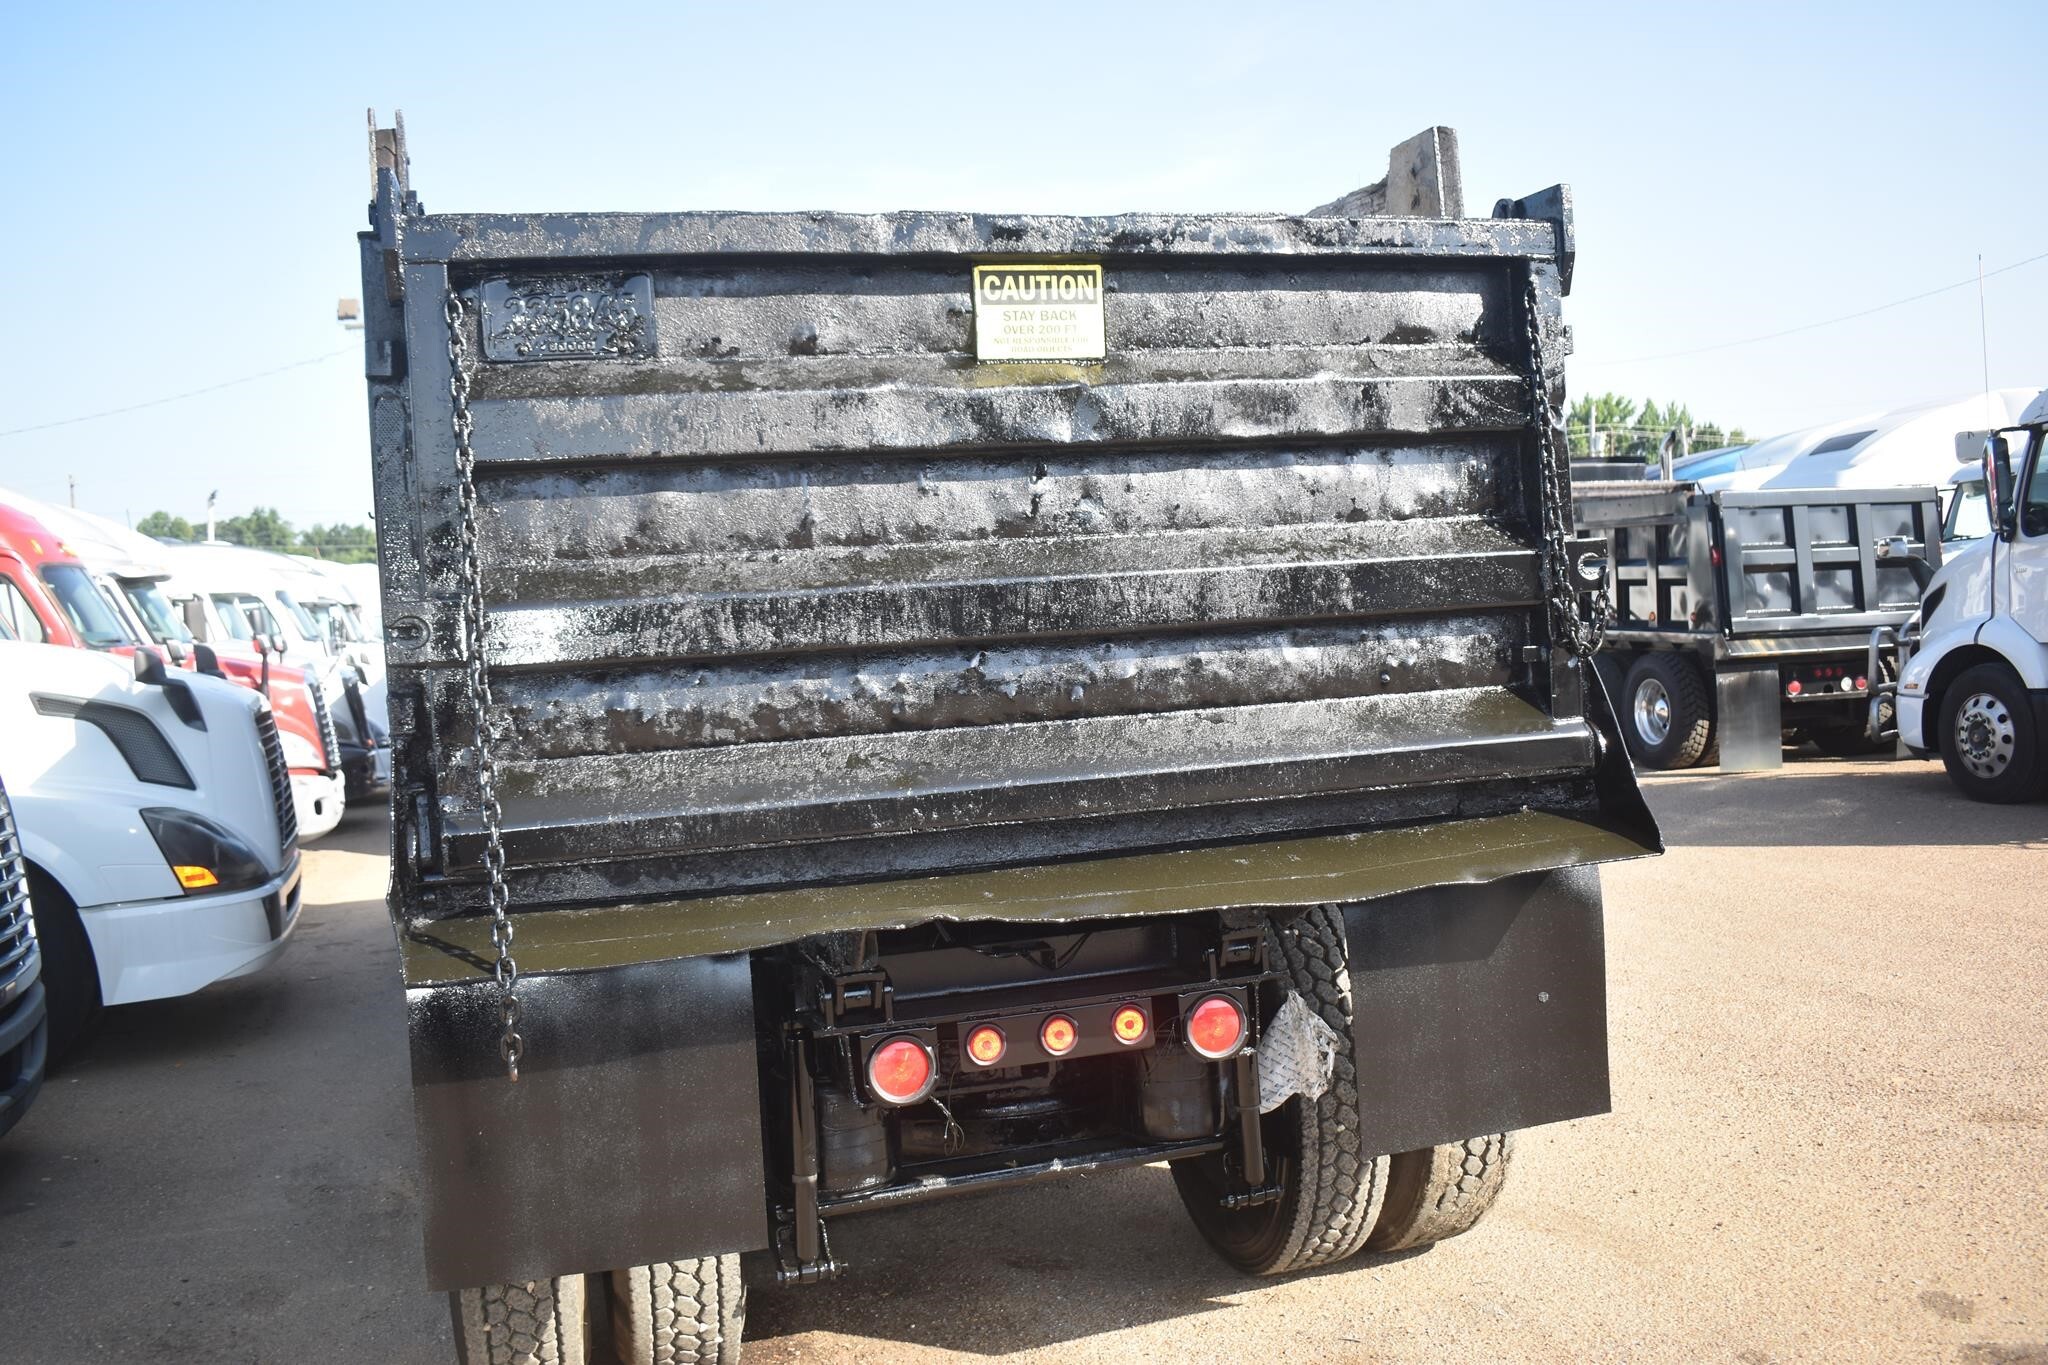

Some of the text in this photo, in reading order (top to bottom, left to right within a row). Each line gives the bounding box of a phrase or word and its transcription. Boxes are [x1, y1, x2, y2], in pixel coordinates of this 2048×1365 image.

[983, 274, 1095, 301] CAUTION
[1002, 310, 1077, 322] STAY BACK
[1003, 325, 1034, 335] OVER
[1039, 324, 1061, 334] 200
